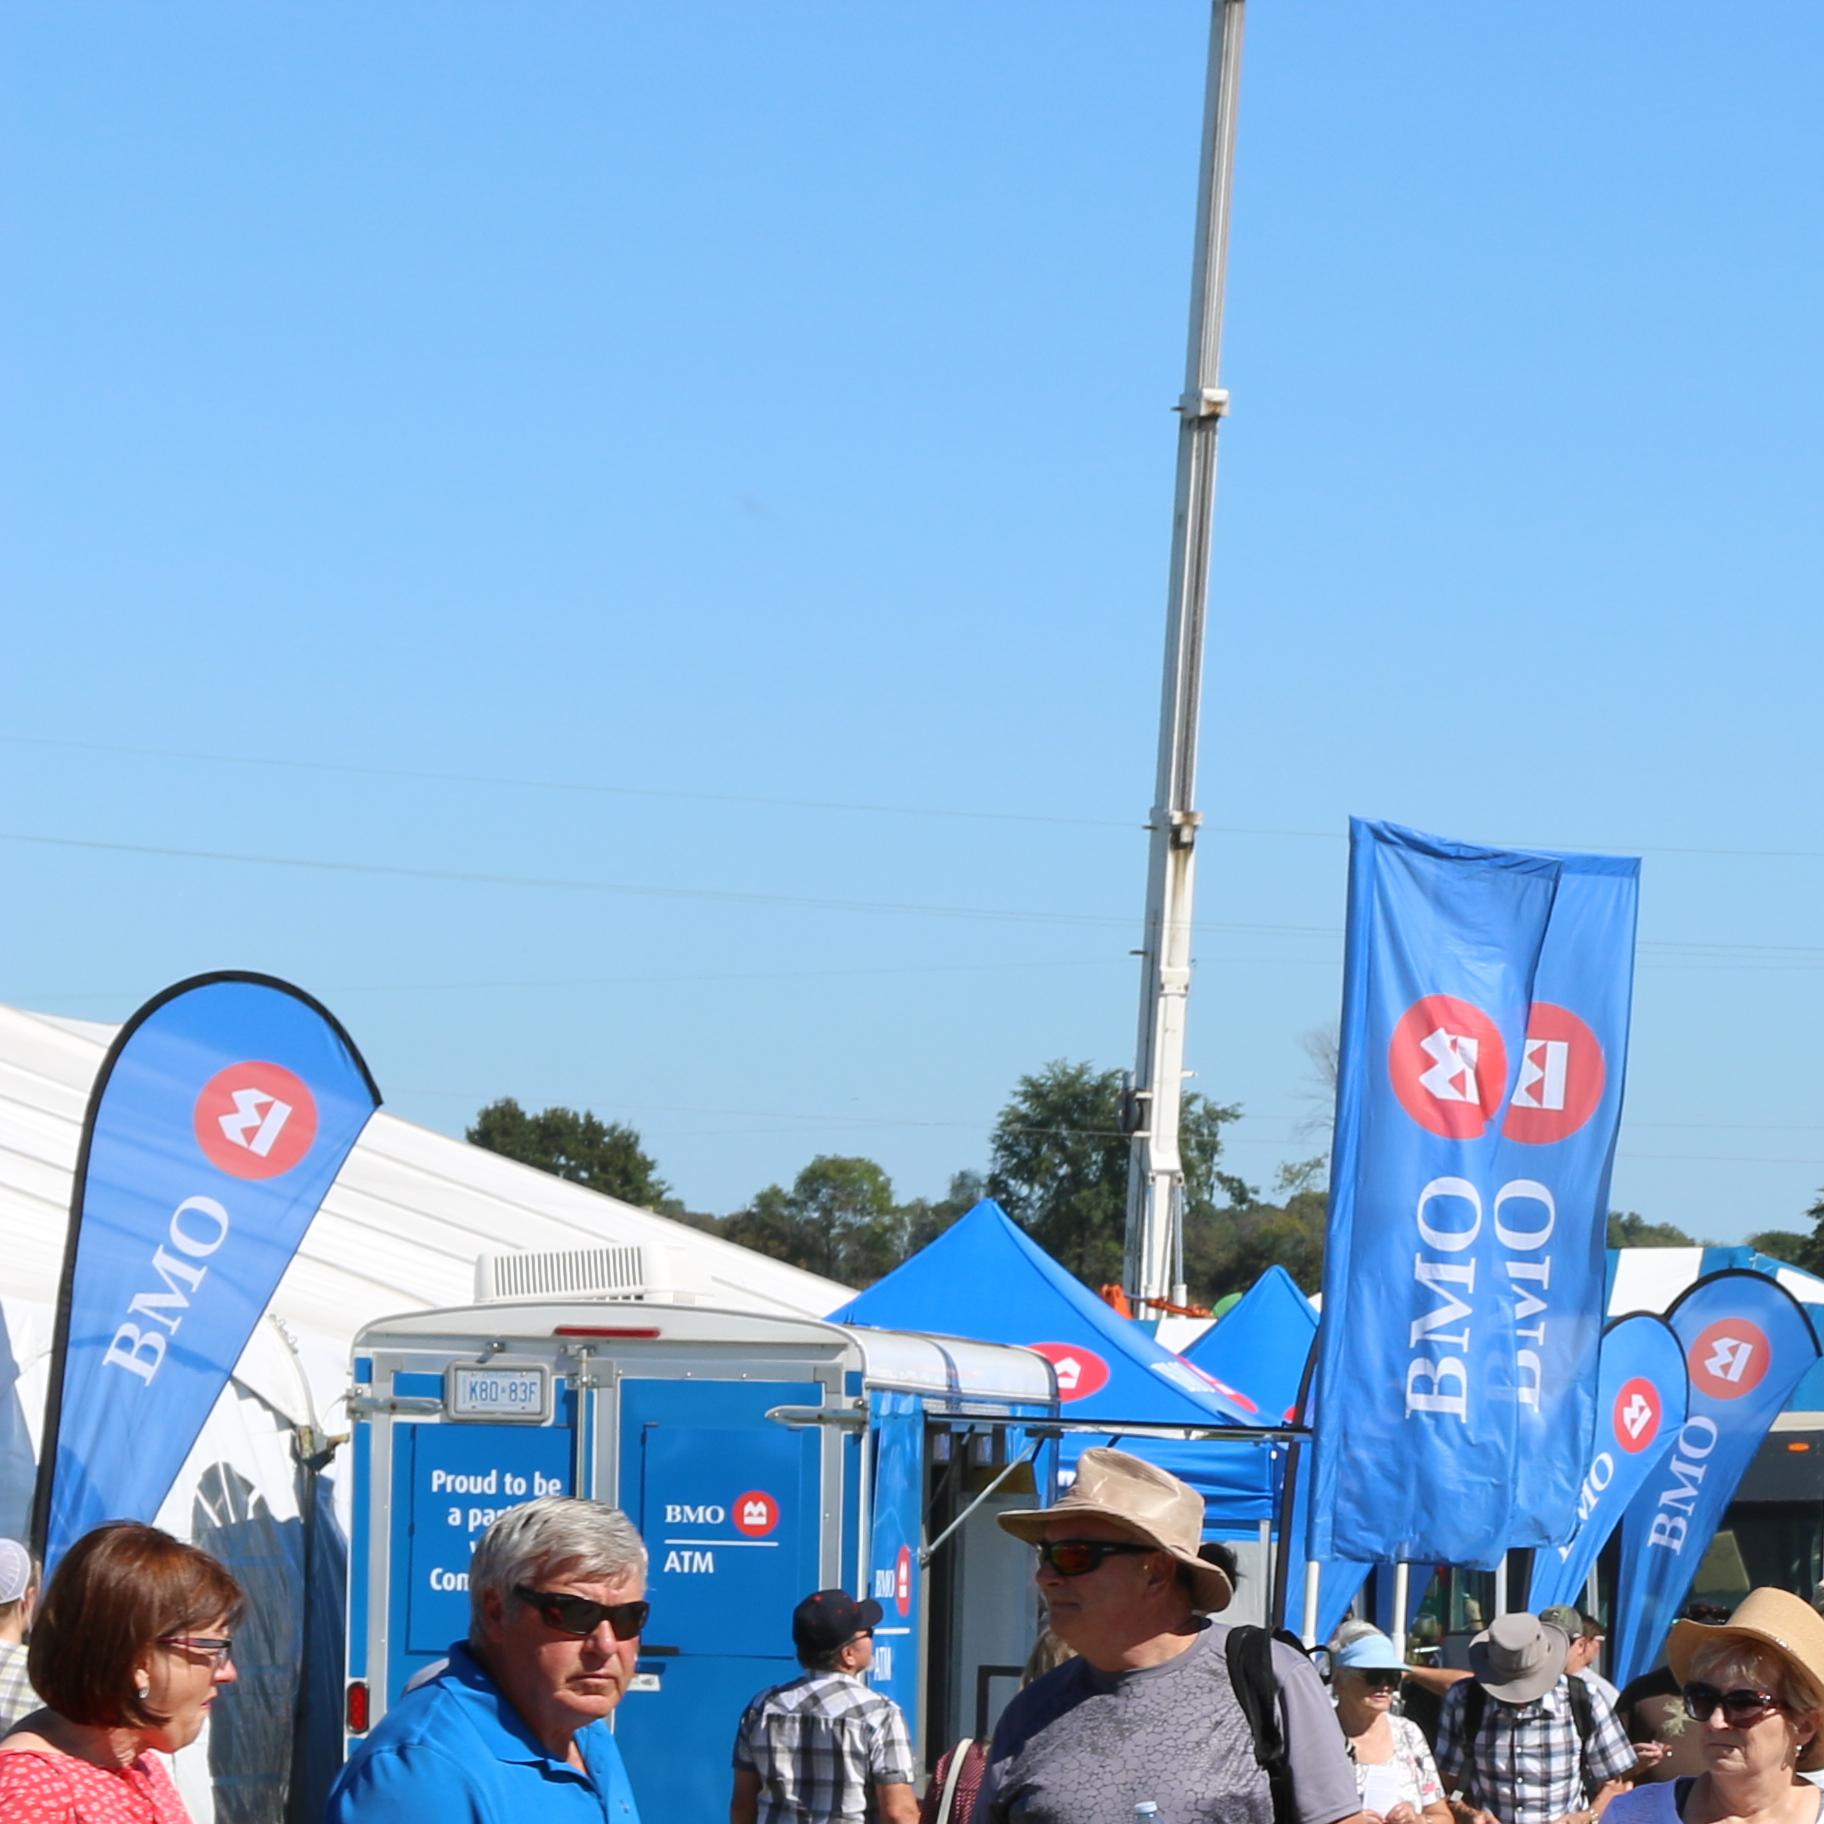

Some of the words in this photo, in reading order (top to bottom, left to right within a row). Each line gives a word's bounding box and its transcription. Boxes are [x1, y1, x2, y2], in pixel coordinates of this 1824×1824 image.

[102, 1196, 229, 1386] BMO
[1405, 1176, 1482, 1423] BMO
[431, 1469, 498, 1495] Proud
[504, 1473, 526, 1495] to
[534, 1472, 562, 1496] be
[1647, 1415, 1718, 1556] BMO
[447, 1508, 461, 1526] a
[665, 1505, 725, 1524] BMO
[663, 1551, 714, 1574] ATM
[875, 1569, 895, 1599] BMO
[874, 1647, 892, 1681] ATM
